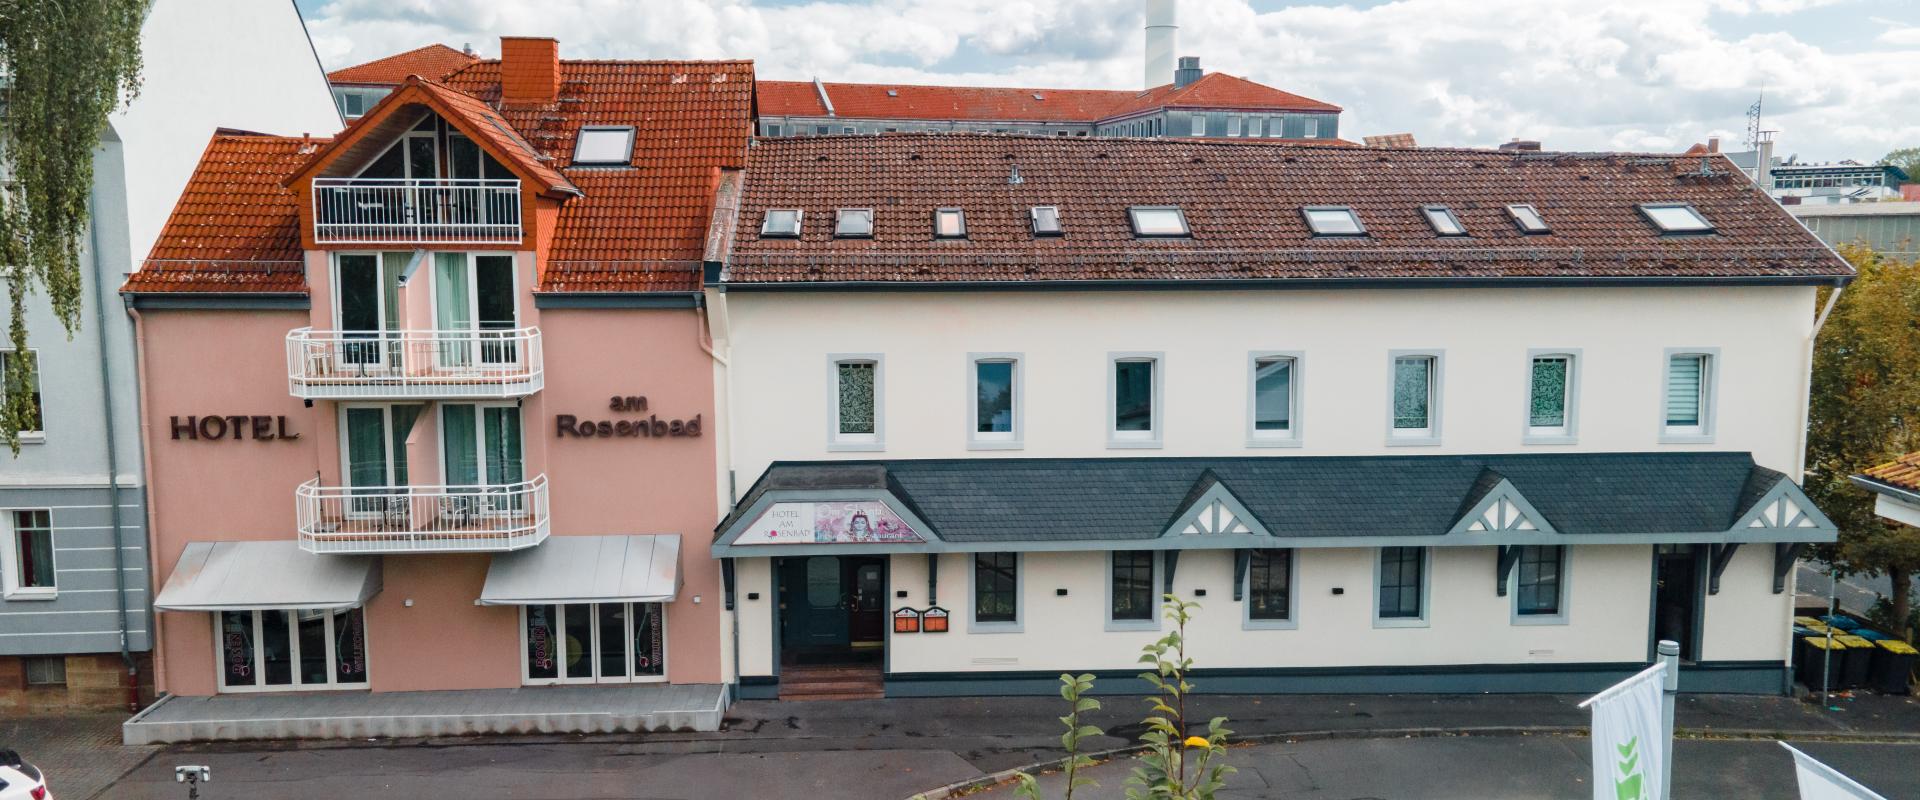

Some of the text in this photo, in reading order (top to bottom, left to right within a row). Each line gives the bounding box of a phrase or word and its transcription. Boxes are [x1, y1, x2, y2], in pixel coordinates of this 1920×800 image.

[609, 396, 648, 412] am
[169, 415, 301, 440] HOTEL
[556, 413, 702, 438] Rosenbad
[772, 510, 800, 518] HOTEL
[778, 520, 795, 529] AM
